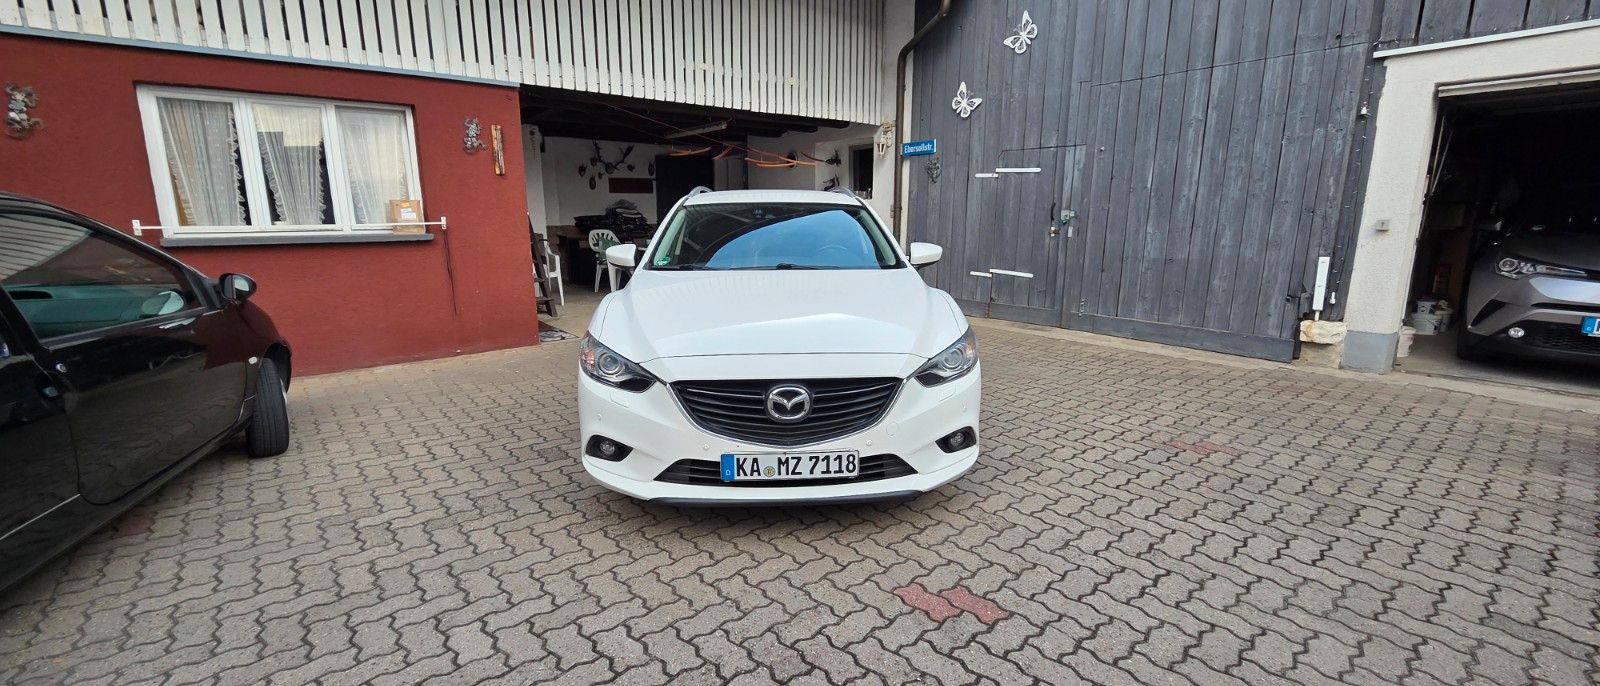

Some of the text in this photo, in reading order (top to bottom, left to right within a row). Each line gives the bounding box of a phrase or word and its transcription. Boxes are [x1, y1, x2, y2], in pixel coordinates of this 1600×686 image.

[736, 454, 857, 477] KA MZ 7118
